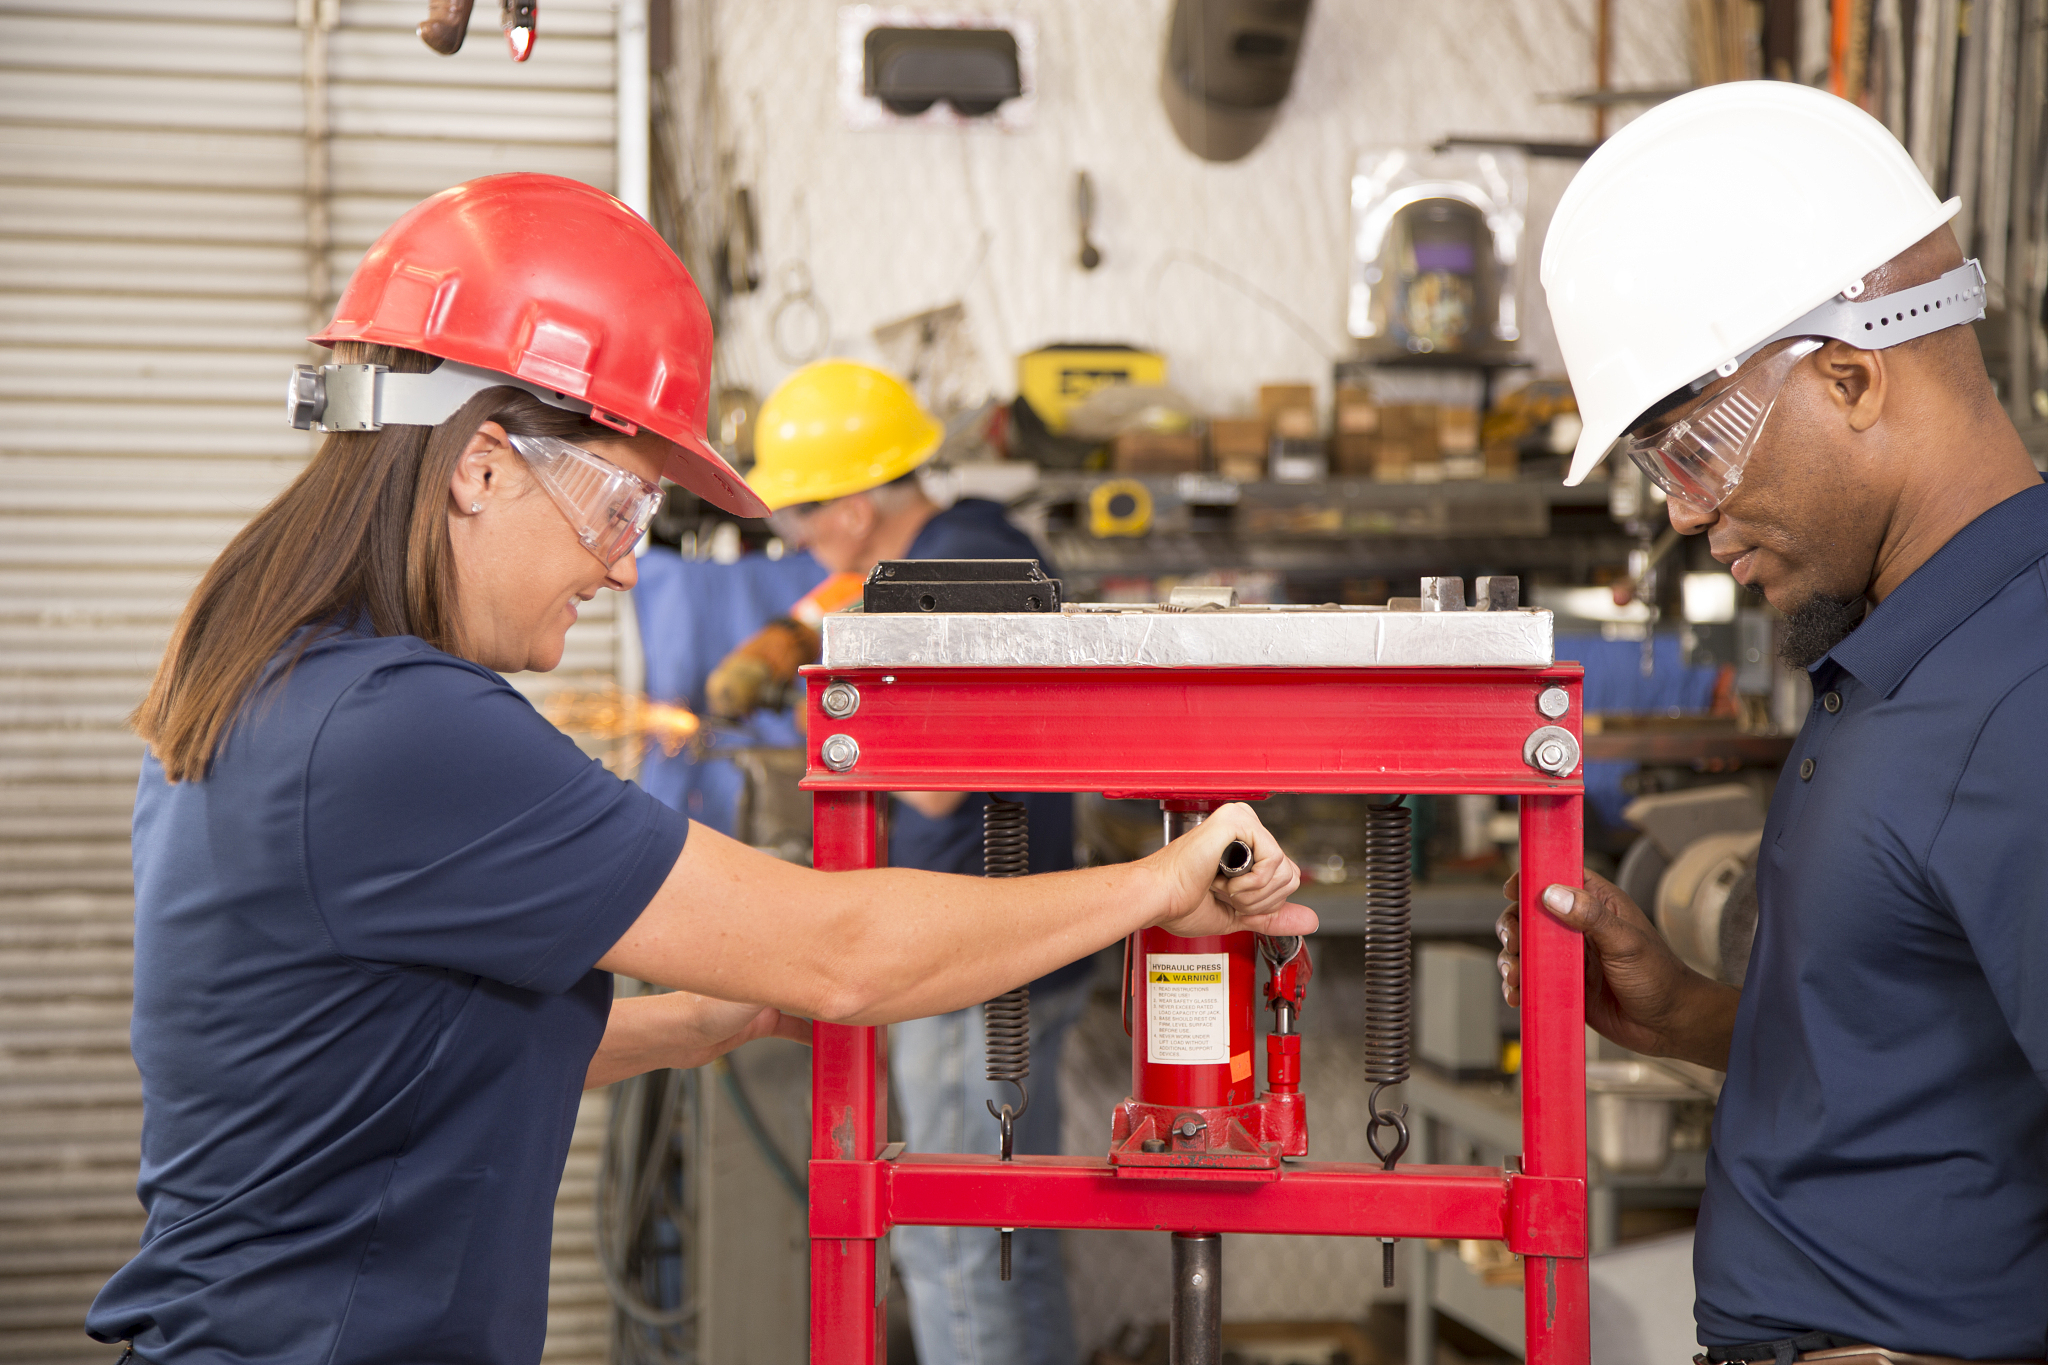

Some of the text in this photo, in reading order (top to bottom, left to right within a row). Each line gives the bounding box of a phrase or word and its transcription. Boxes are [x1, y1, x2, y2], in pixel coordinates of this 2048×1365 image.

[1152, 963, 1221, 971] HYDRAULIC PRESS
[1172, 974, 1218, 982] WARNING!
